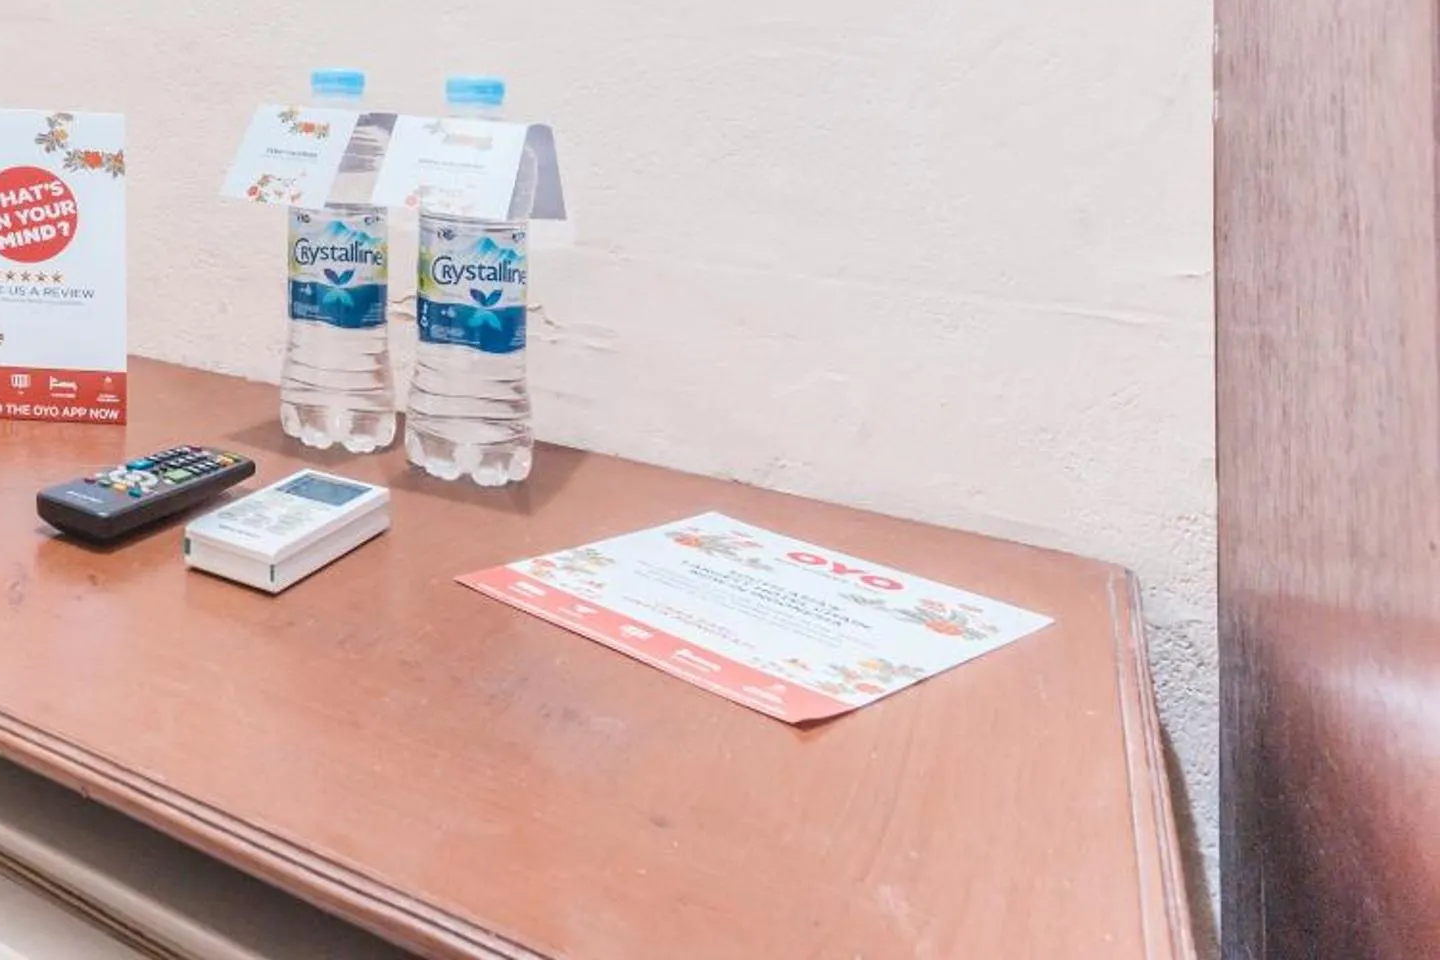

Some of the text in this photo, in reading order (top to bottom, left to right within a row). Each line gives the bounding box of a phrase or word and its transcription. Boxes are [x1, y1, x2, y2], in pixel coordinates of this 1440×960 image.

[15, 199, 77, 225] YOUR
[9, 285, 26, 296] US
[29, 286, 40, 296] A
[43, 287, 95, 299] REVIEW
[6, 405, 30, 416] THE
[33, 406, 60, 417] OYO
[62, 407, 87, 418] APP
[89, 409, 120, 420] NOW
[787, 551, 904, 591] OYO
